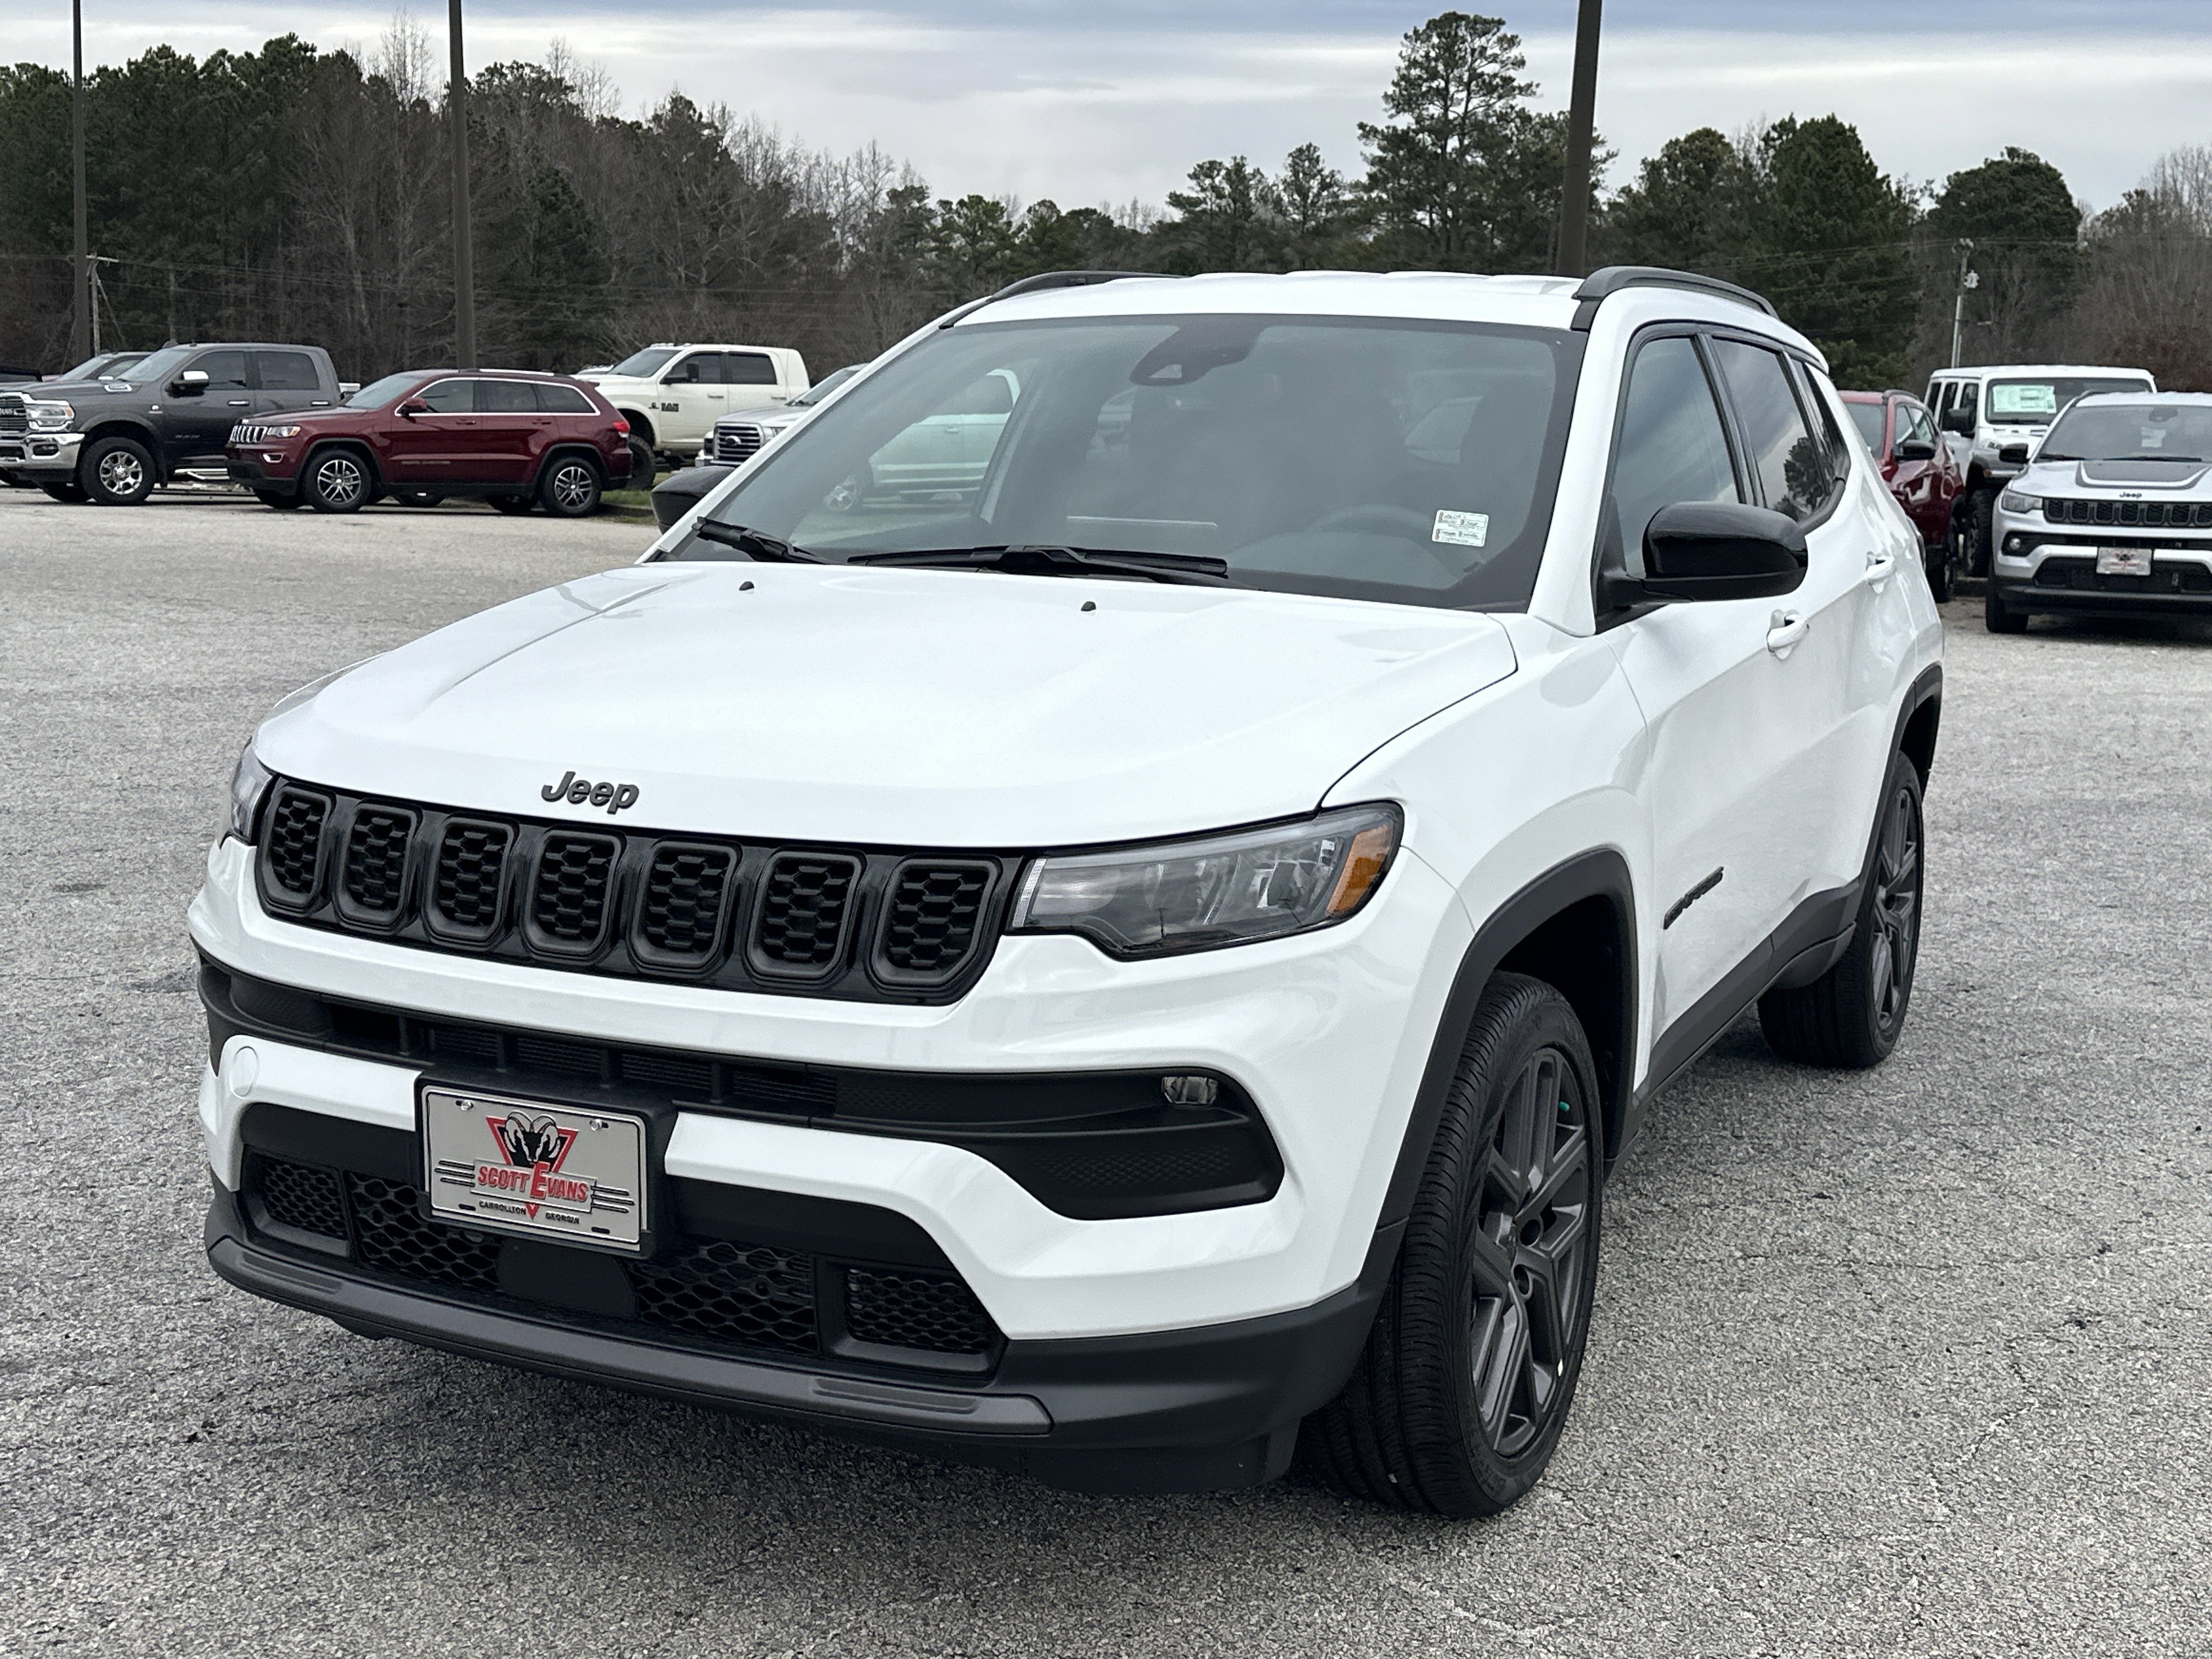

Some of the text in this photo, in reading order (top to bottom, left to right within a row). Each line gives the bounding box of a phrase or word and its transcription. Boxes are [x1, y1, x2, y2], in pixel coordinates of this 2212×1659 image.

[541, 771, 640, 815] Jeep
[477, 1160, 589, 1203] SCOTT EVANS
[479, 1200, 580, 1224] CARROLLTON GEORGIA
